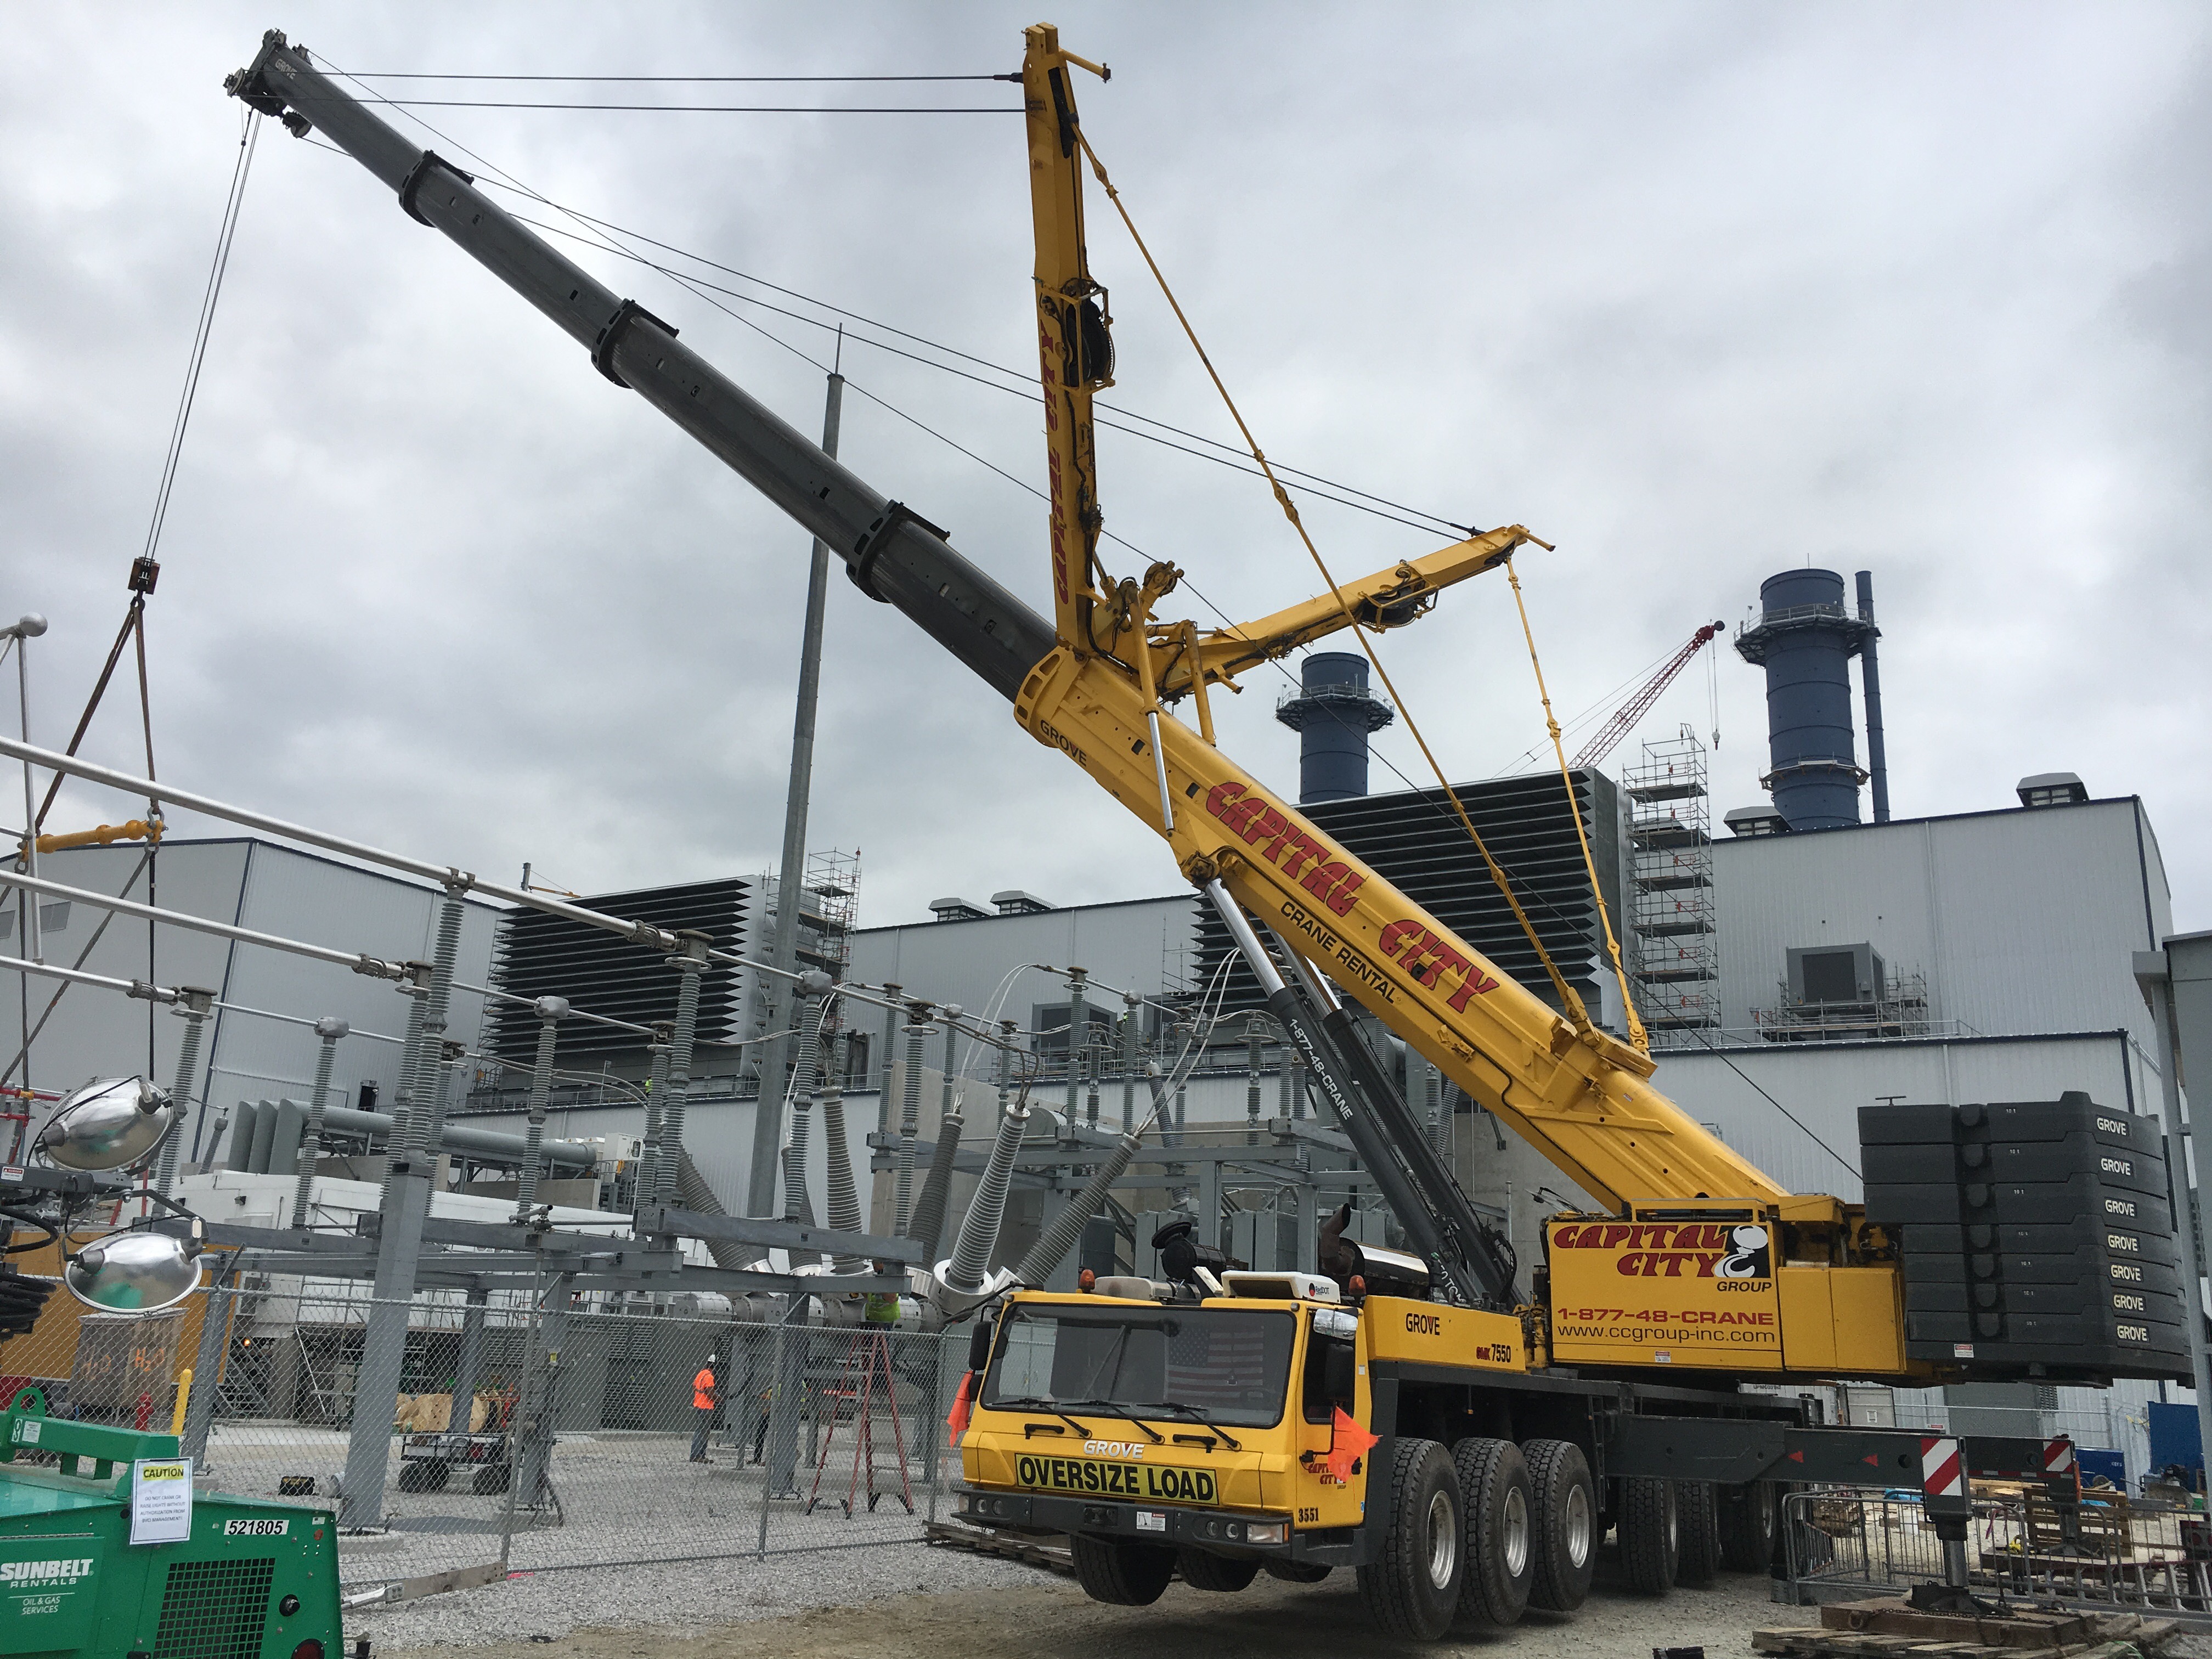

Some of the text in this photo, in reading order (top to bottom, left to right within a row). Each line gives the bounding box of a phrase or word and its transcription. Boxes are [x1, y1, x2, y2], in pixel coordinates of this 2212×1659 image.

[275, 58, 297, 80] GROVE
[1040, 319, 1069, 605] CAPITAL CITY
[1040, 719, 1086, 766] GROVE
[1206, 782, 1500, 1014] CAPITAL CITY
[1280, 901, 1395, 1004] CRANE RENTAL
[1290, 1019, 1353, 1120] 1-877-48-CRANE
[2097, 1118, 2126, 1136] GROVE
[2101, 1158, 2131, 1176] GROVE
[2105, 1199, 2135, 1217] GROVE
[1554, 1225, 1730, 1249] CAPITAL
[2108, 1235, 2138, 1251] GROVE
[1617, 1252, 1729, 1277] CITY
[2111, 1265, 2141, 1281] GROVE
[1717, 1282, 1772, 1293] GROUP
[2114, 1295, 2144, 1311] GROVE
[1406, 1313, 1440, 1335] GROVE
[1558, 1308, 1774, 1325] 1-877-48-CRANE
[1558, 1325, 1775, 1344] www.ccgroup-inc.com
[2117, 1325, 2148, 1341] GROVE
[1491, 1344, 1511, 1363] 7550
[1084, 1440, 1145, 1459] GROVE
[143, 1468, 184, 1478] CAUTION
[1019, 1457, 1214, 1501] OVERSIZE LOAD
[1298, 1507, 1319, 1522] 3551
[228, 1520, 284, 1535] 521805
[0, 1559, 94, 1581] SUNBELT
[10, 1577, 77, 1588] RENTALS
[21, 1605, 59, 1615] SERVICES
[22, 1596, 61, 1606] OIL & GAS
